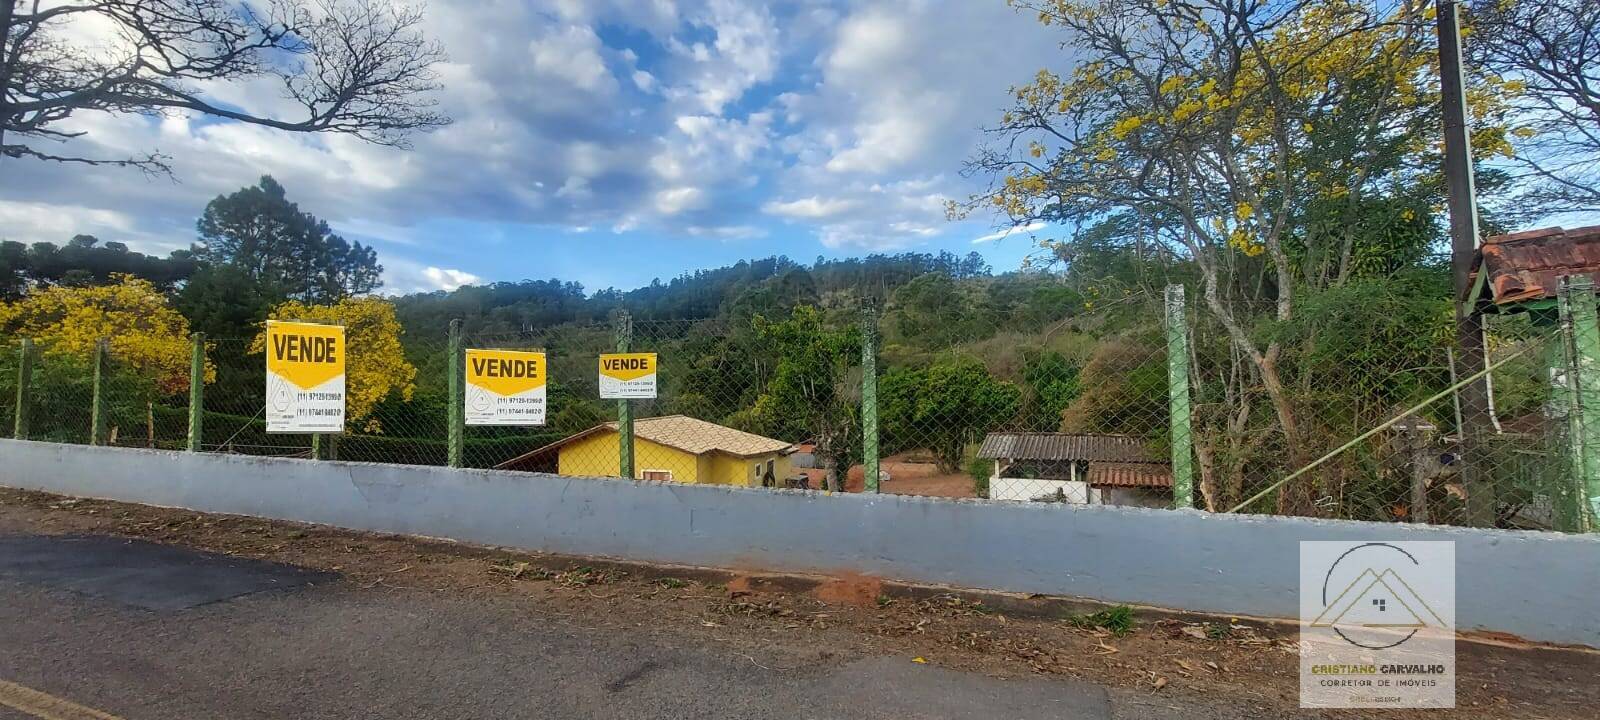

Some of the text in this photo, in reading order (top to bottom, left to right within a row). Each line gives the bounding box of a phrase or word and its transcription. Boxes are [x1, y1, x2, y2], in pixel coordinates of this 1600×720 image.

[273, 334, 337, 363] VENDE
[472, 358, 537, 378] VENDE
[603, 359, 648, 370] VENDE
